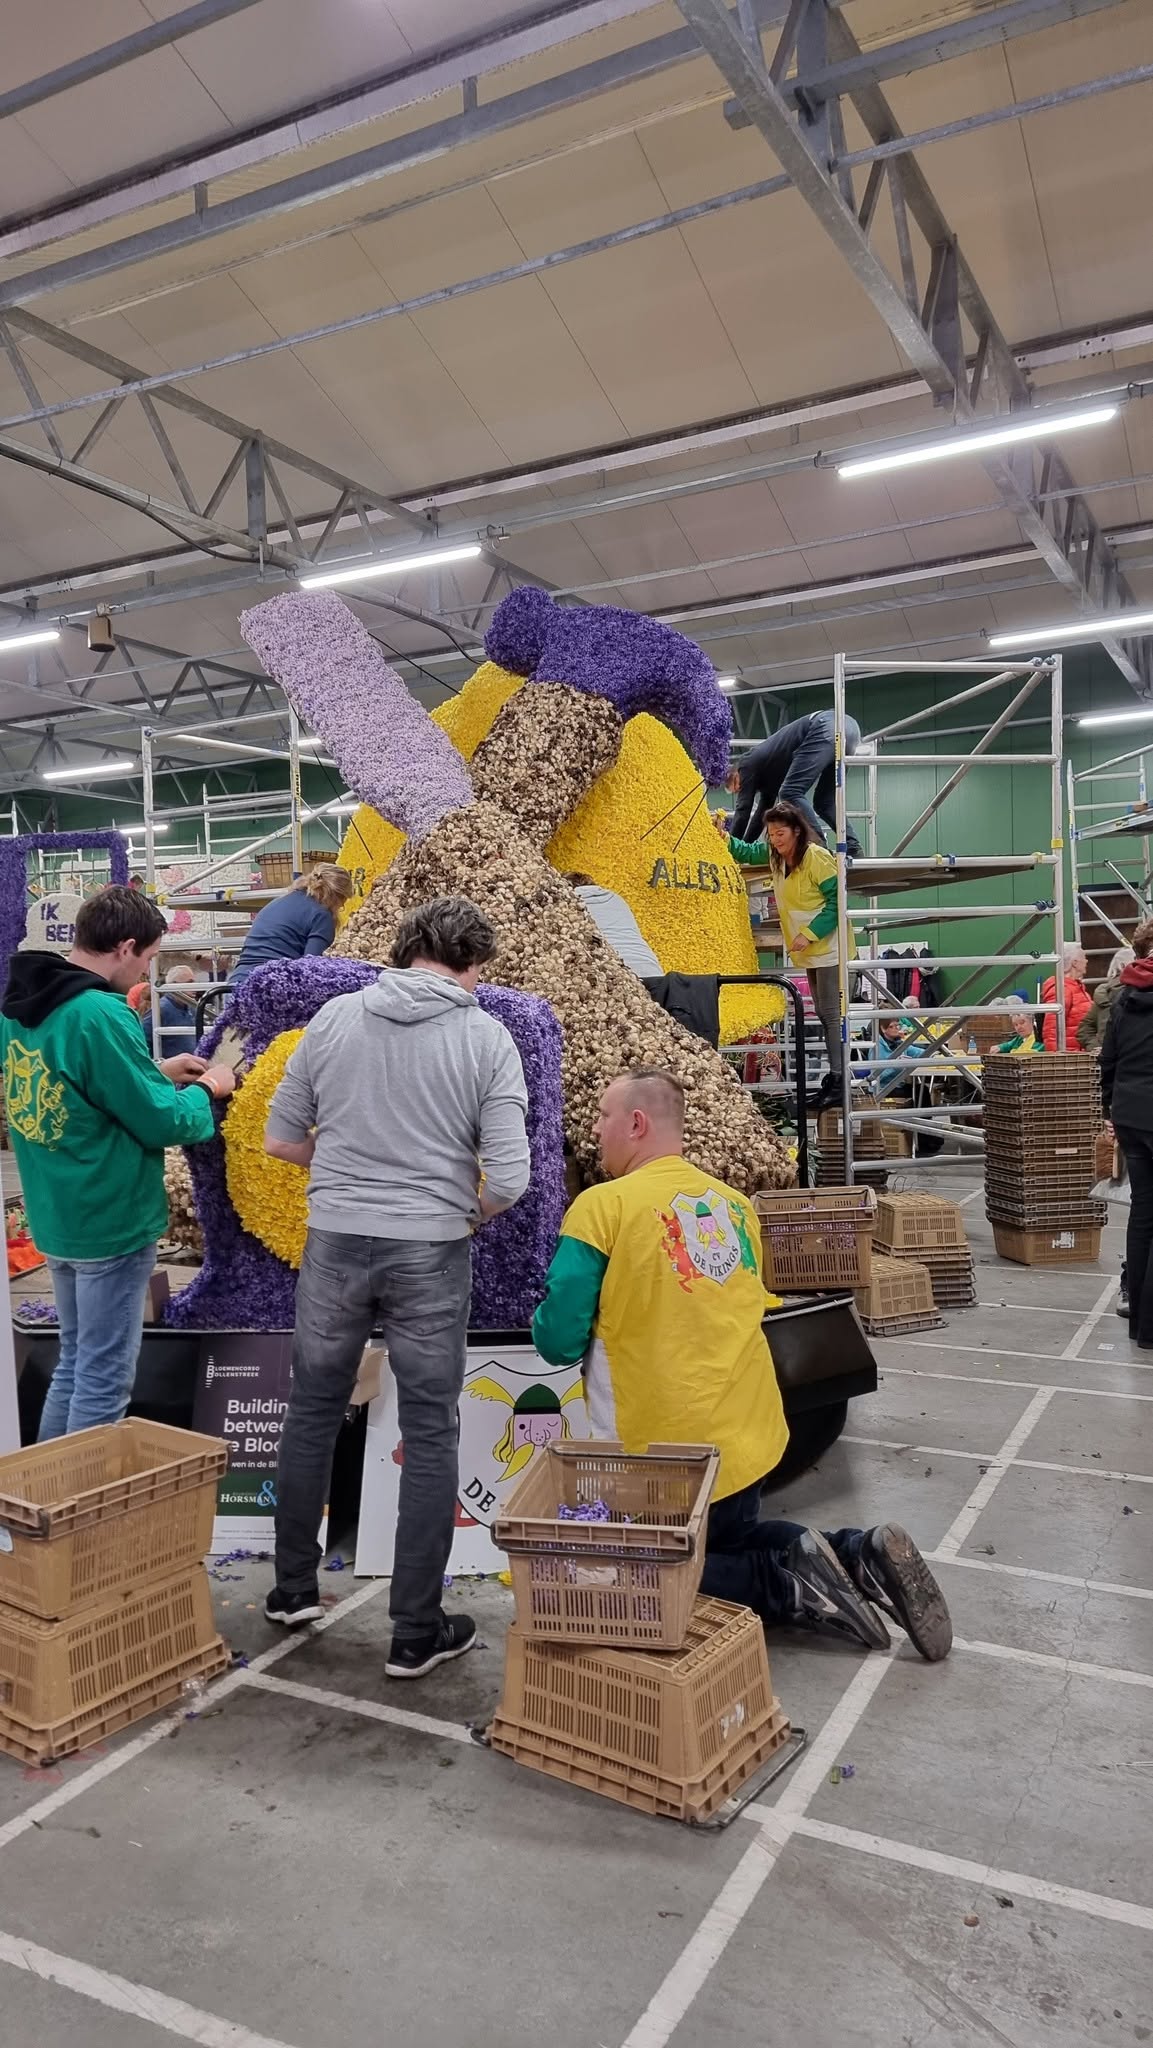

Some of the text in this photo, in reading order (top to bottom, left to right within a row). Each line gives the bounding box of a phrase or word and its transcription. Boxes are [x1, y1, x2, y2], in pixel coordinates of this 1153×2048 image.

[647, 857, 721, 893] ALLES
[41, 902, 60, 921] IK
[694, 1245, 739, 1277] DE VIKINGS
[227, 1398, 288, 1414] Buildin
[223, 1418, 284, 1433] betwe
[247, 1460, 256, 1468] in
[257, 1460, 267, 1468] de
[220, 1493, 270, 1503] HORSMAN
[463, 1477, 497, 1513] DE
